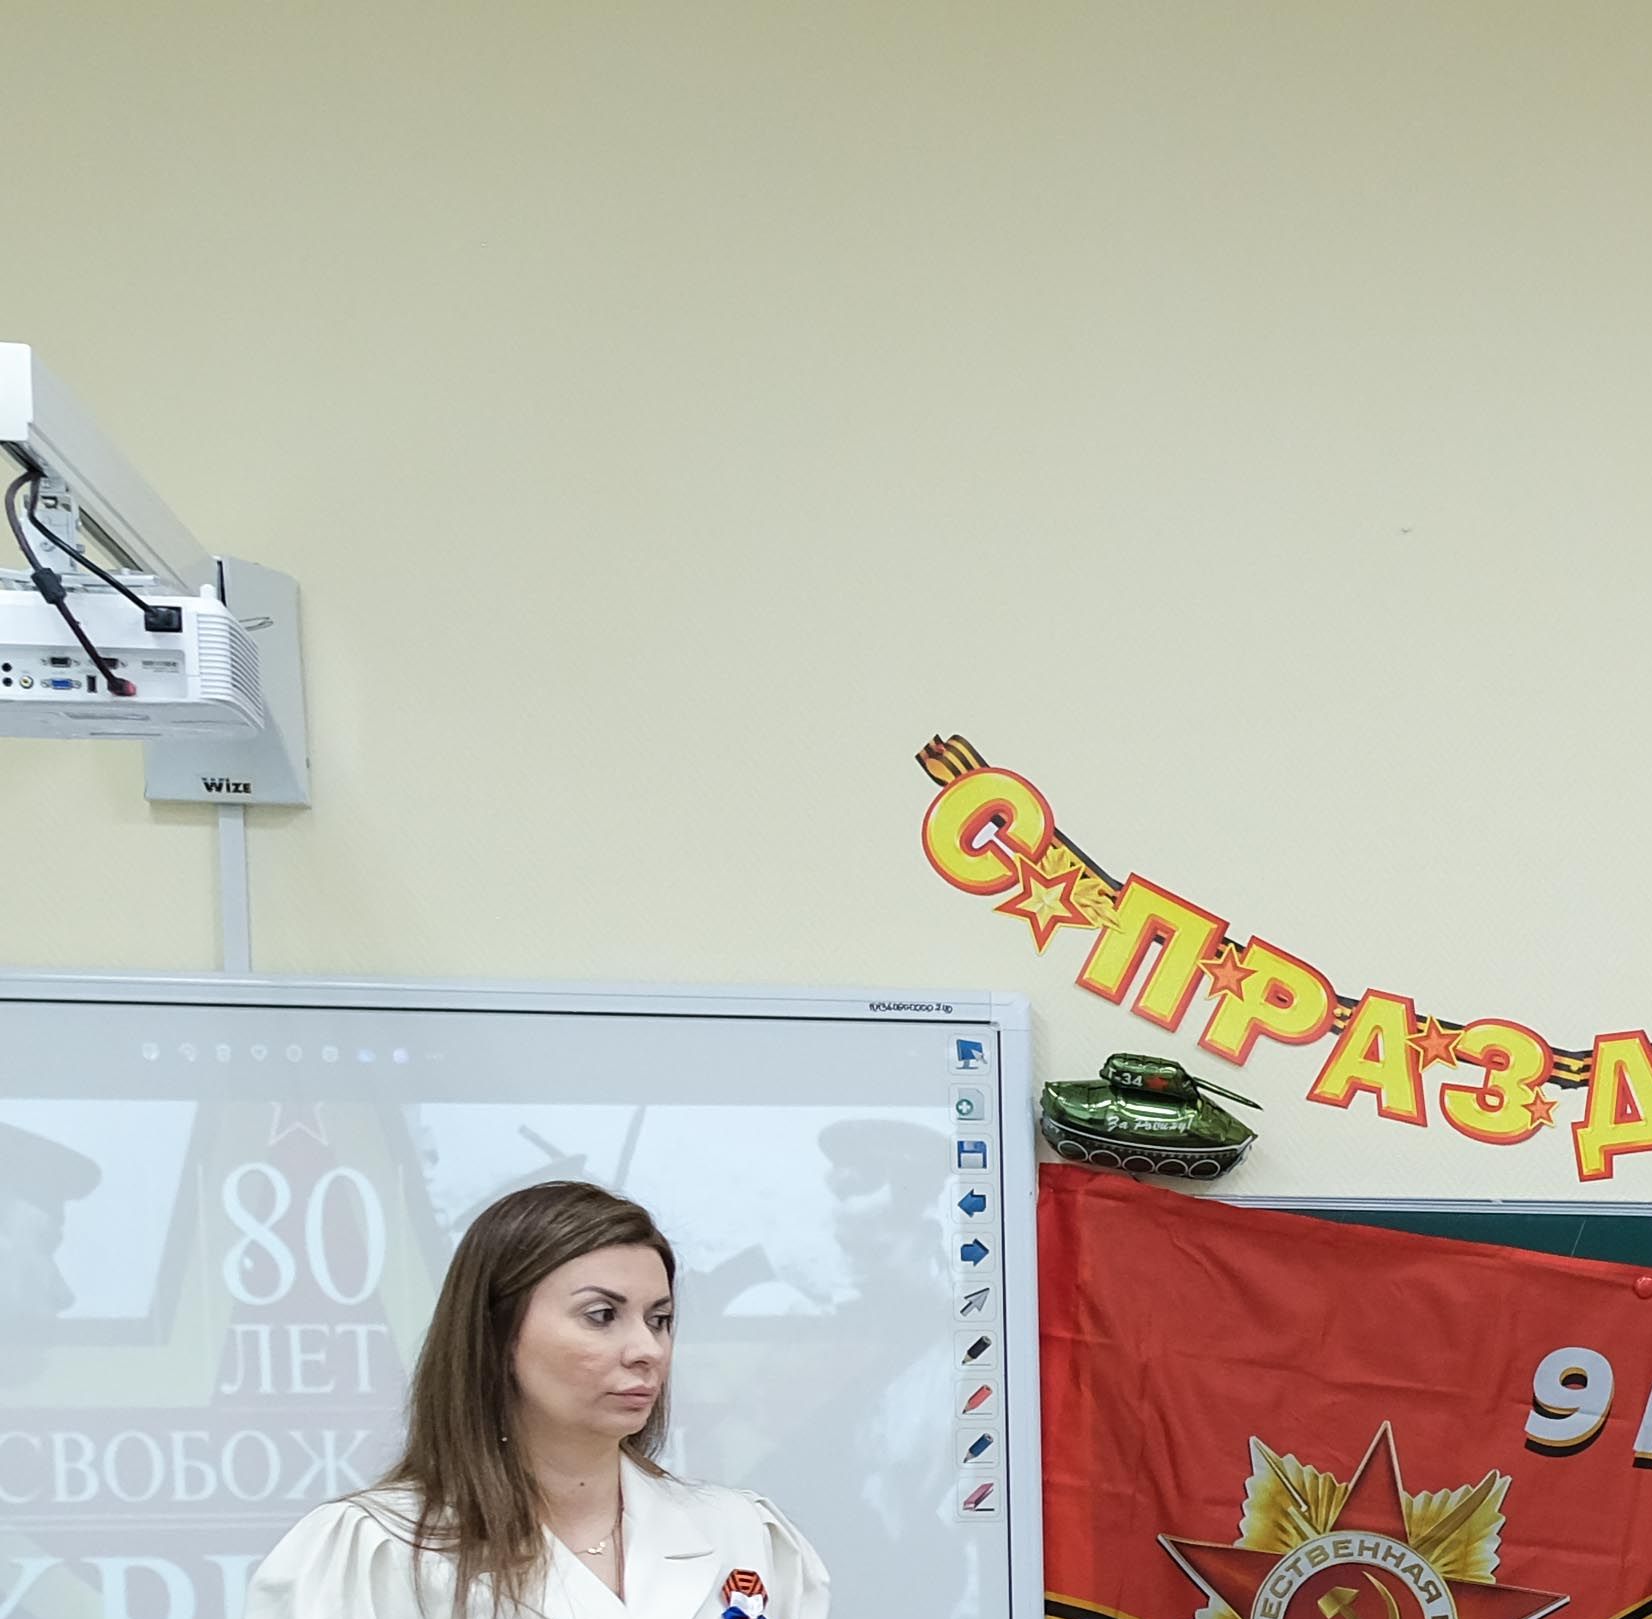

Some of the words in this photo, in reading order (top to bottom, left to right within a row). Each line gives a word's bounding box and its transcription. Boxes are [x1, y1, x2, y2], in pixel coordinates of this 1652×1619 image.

[921, 767, 1056, 895] С
[222, 1161, 388, 1309] 80
[222, 1322, 388, 1398] ЛЕТ
[1524, 1346, 1615, 1454] 9
